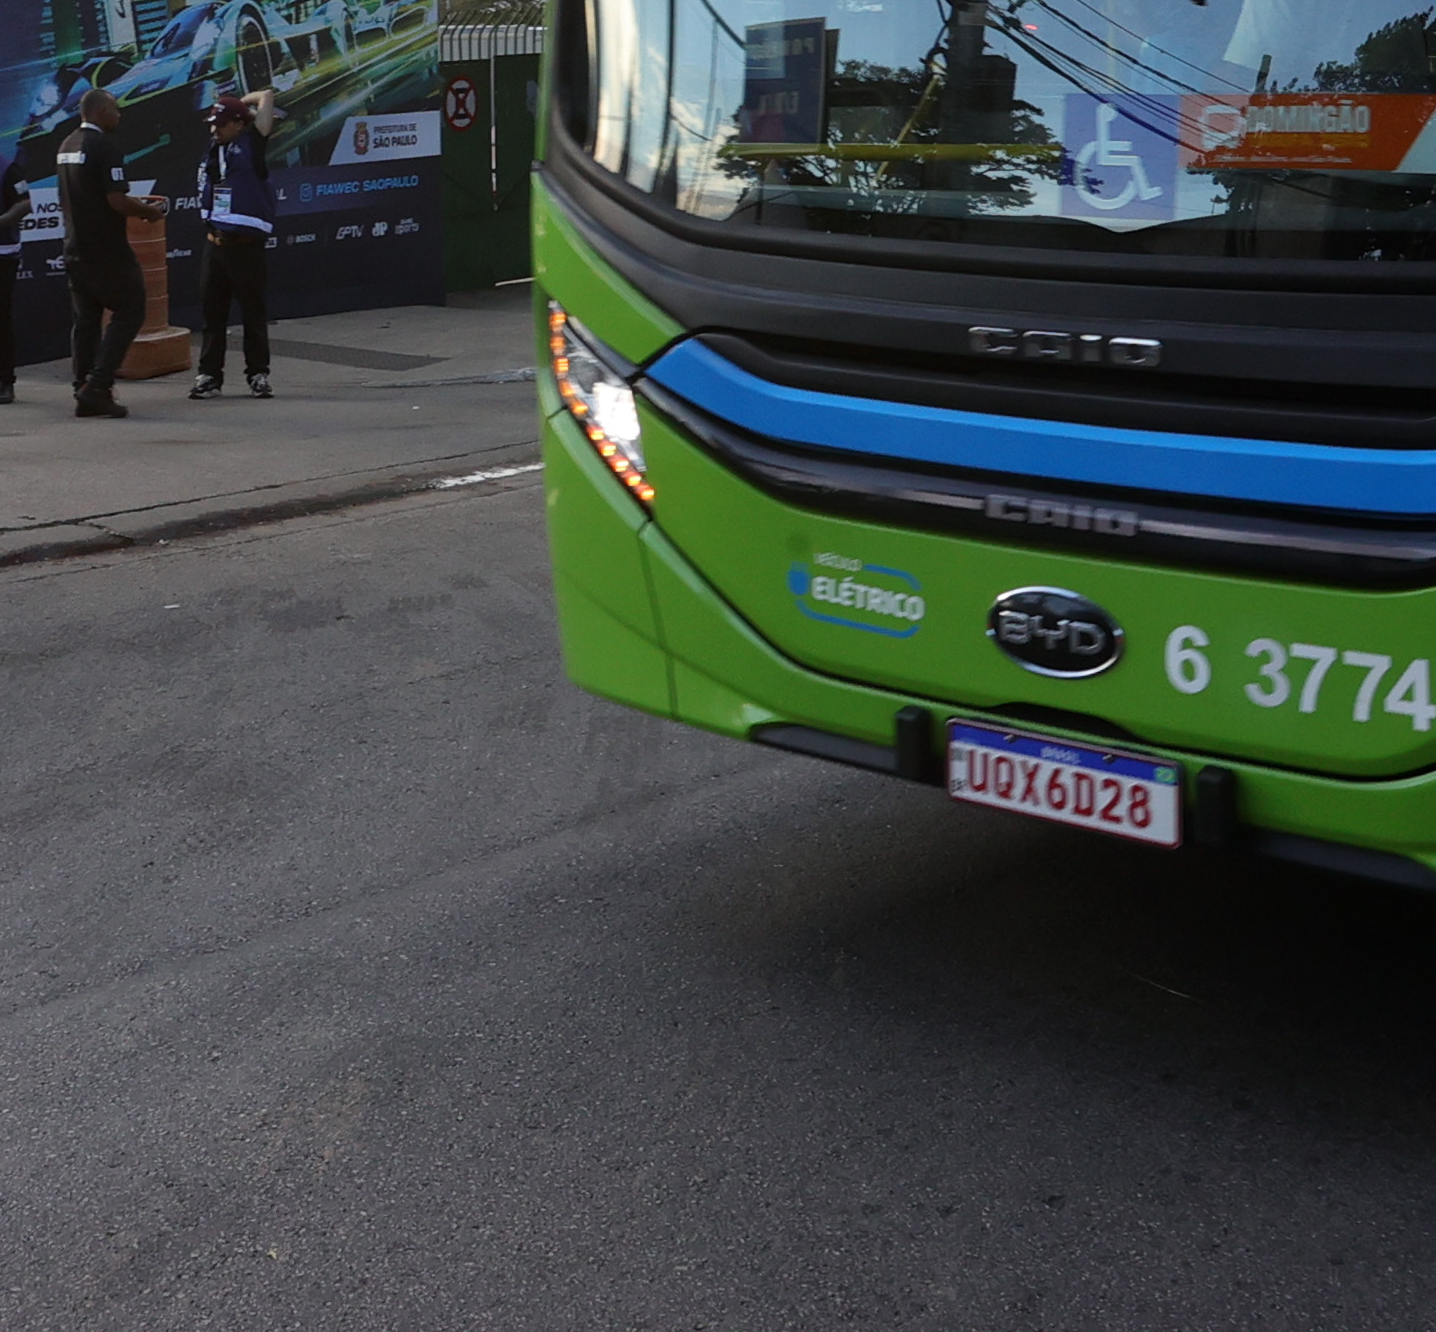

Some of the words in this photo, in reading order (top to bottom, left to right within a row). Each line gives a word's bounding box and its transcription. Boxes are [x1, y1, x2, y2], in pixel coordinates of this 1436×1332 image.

[373, 124, 409, 134] PREFEITURA
[373, 136, 390, 148] SÃO
[391, 134, 417, 147] PAULO
[984, 493, 1140, 537] CAIO
[811, 576, 926, 621] ELÉTRICO
[998, 610, 1106, 656] BYD
[1164, 625, 1213, 695] 6
[967, 748, 1152, 829] UQX6D28
